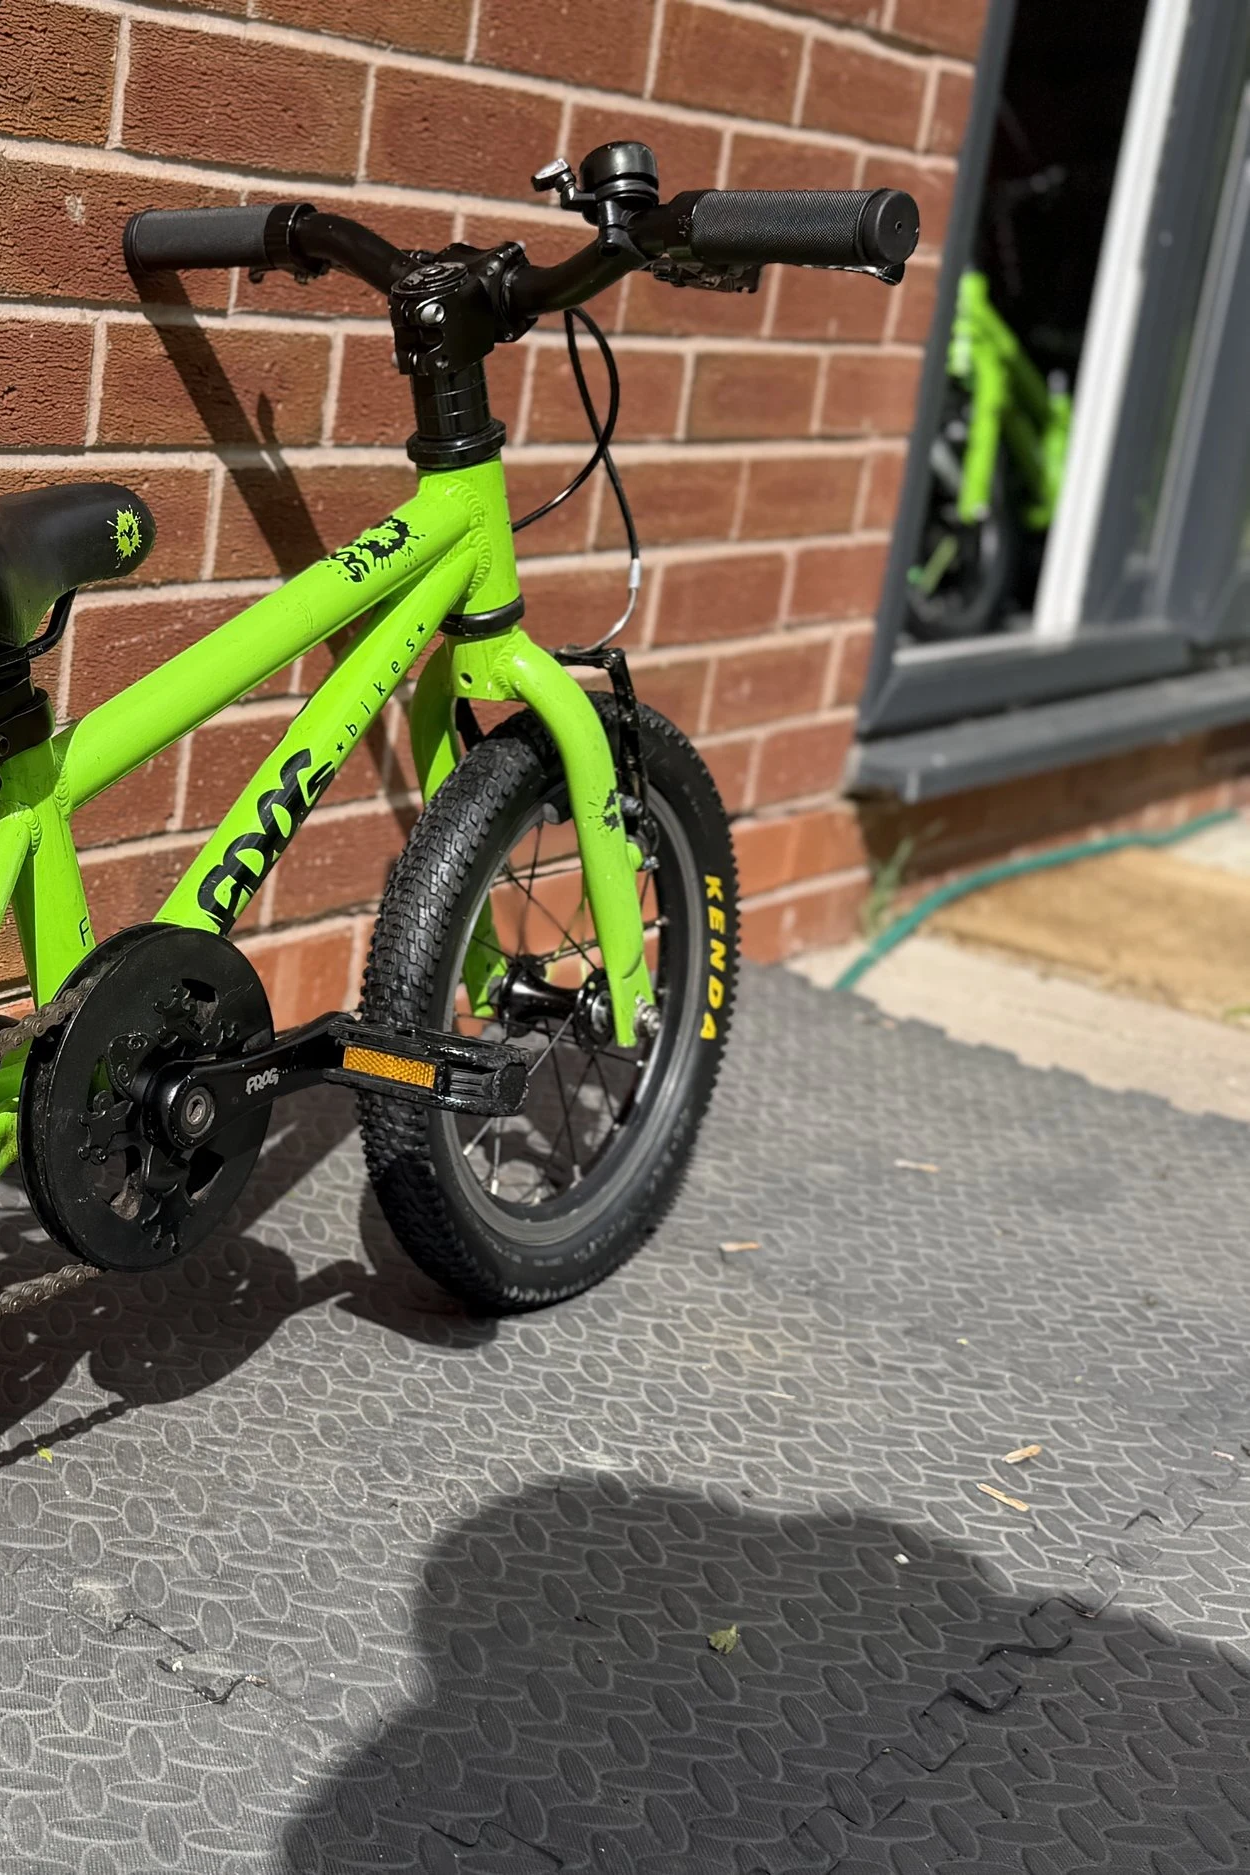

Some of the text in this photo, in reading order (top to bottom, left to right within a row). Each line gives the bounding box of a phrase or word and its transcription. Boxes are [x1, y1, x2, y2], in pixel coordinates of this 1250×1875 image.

[344, 637, 416, 738] bikes
[700, 875, 726, 1040] KENDA
[245, 1067, 280, 1096] FROG
